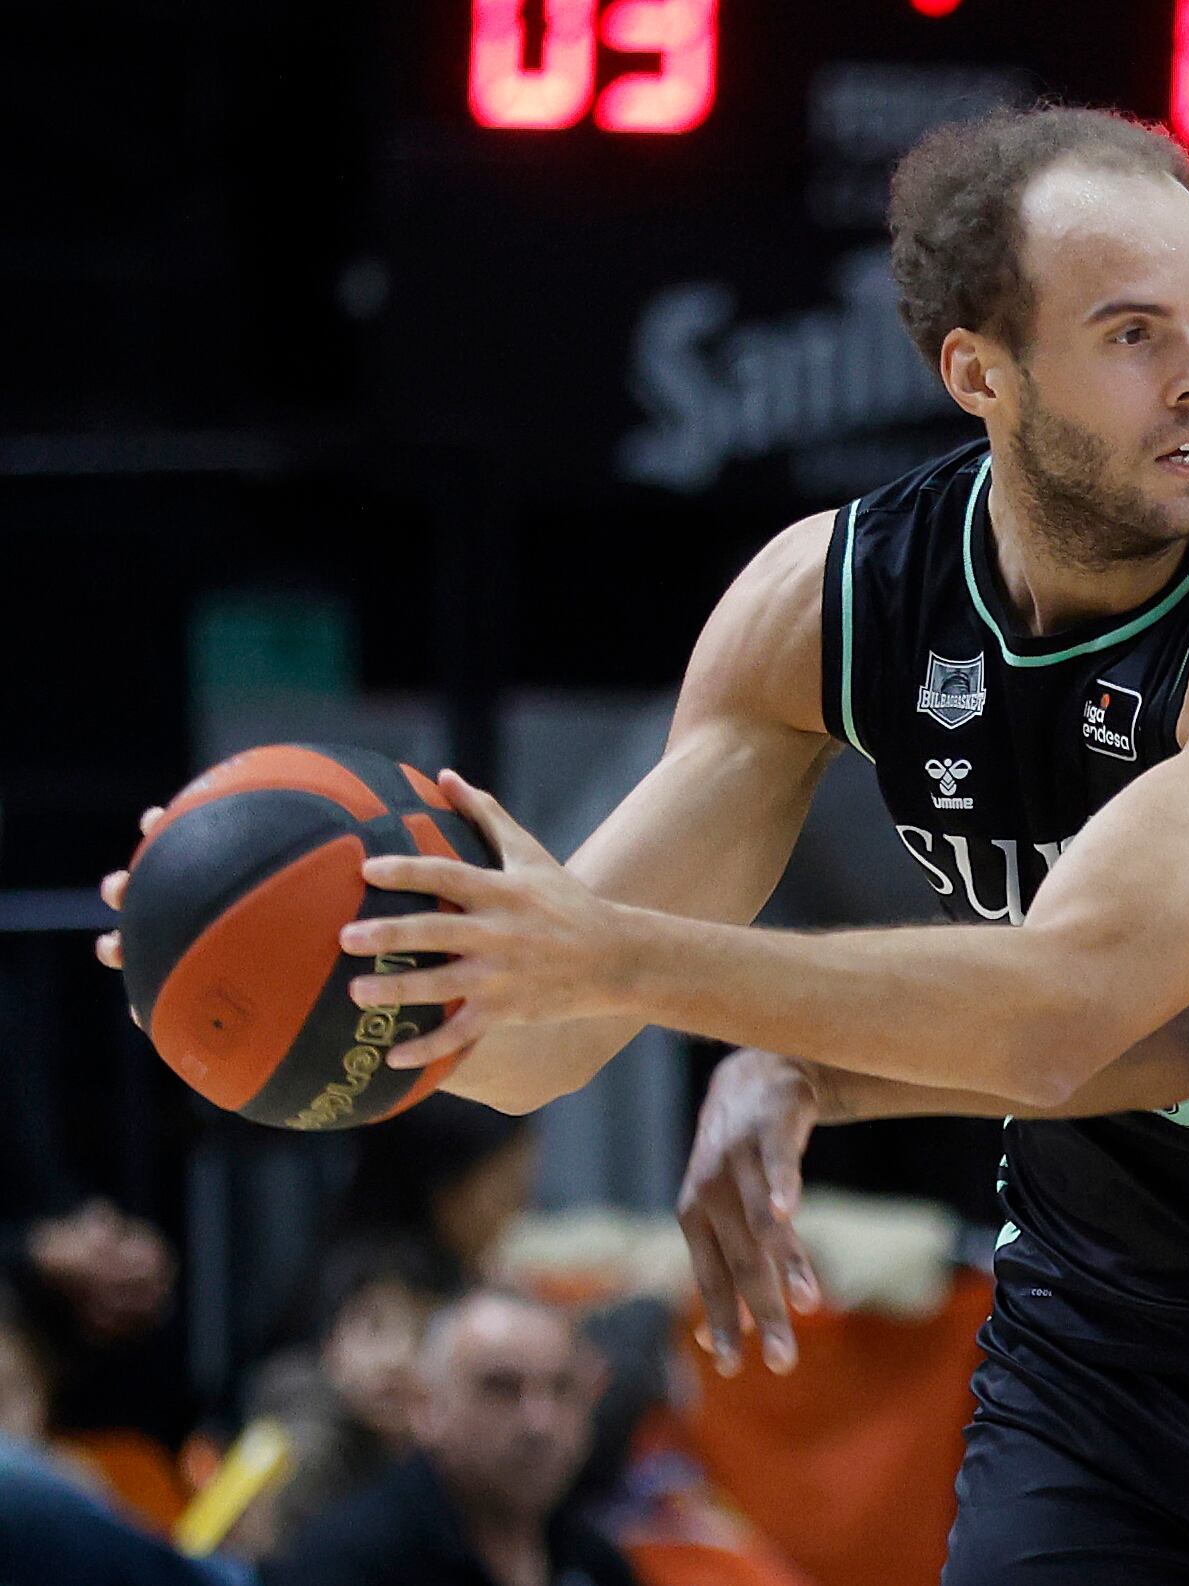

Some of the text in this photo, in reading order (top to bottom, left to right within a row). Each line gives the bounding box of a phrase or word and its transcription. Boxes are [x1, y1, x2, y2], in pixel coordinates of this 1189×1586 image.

[1083, 700, 1106, 724] liga
[1082, 723, 1131, 751] endesa
[928, 790, 974, 810] umme
